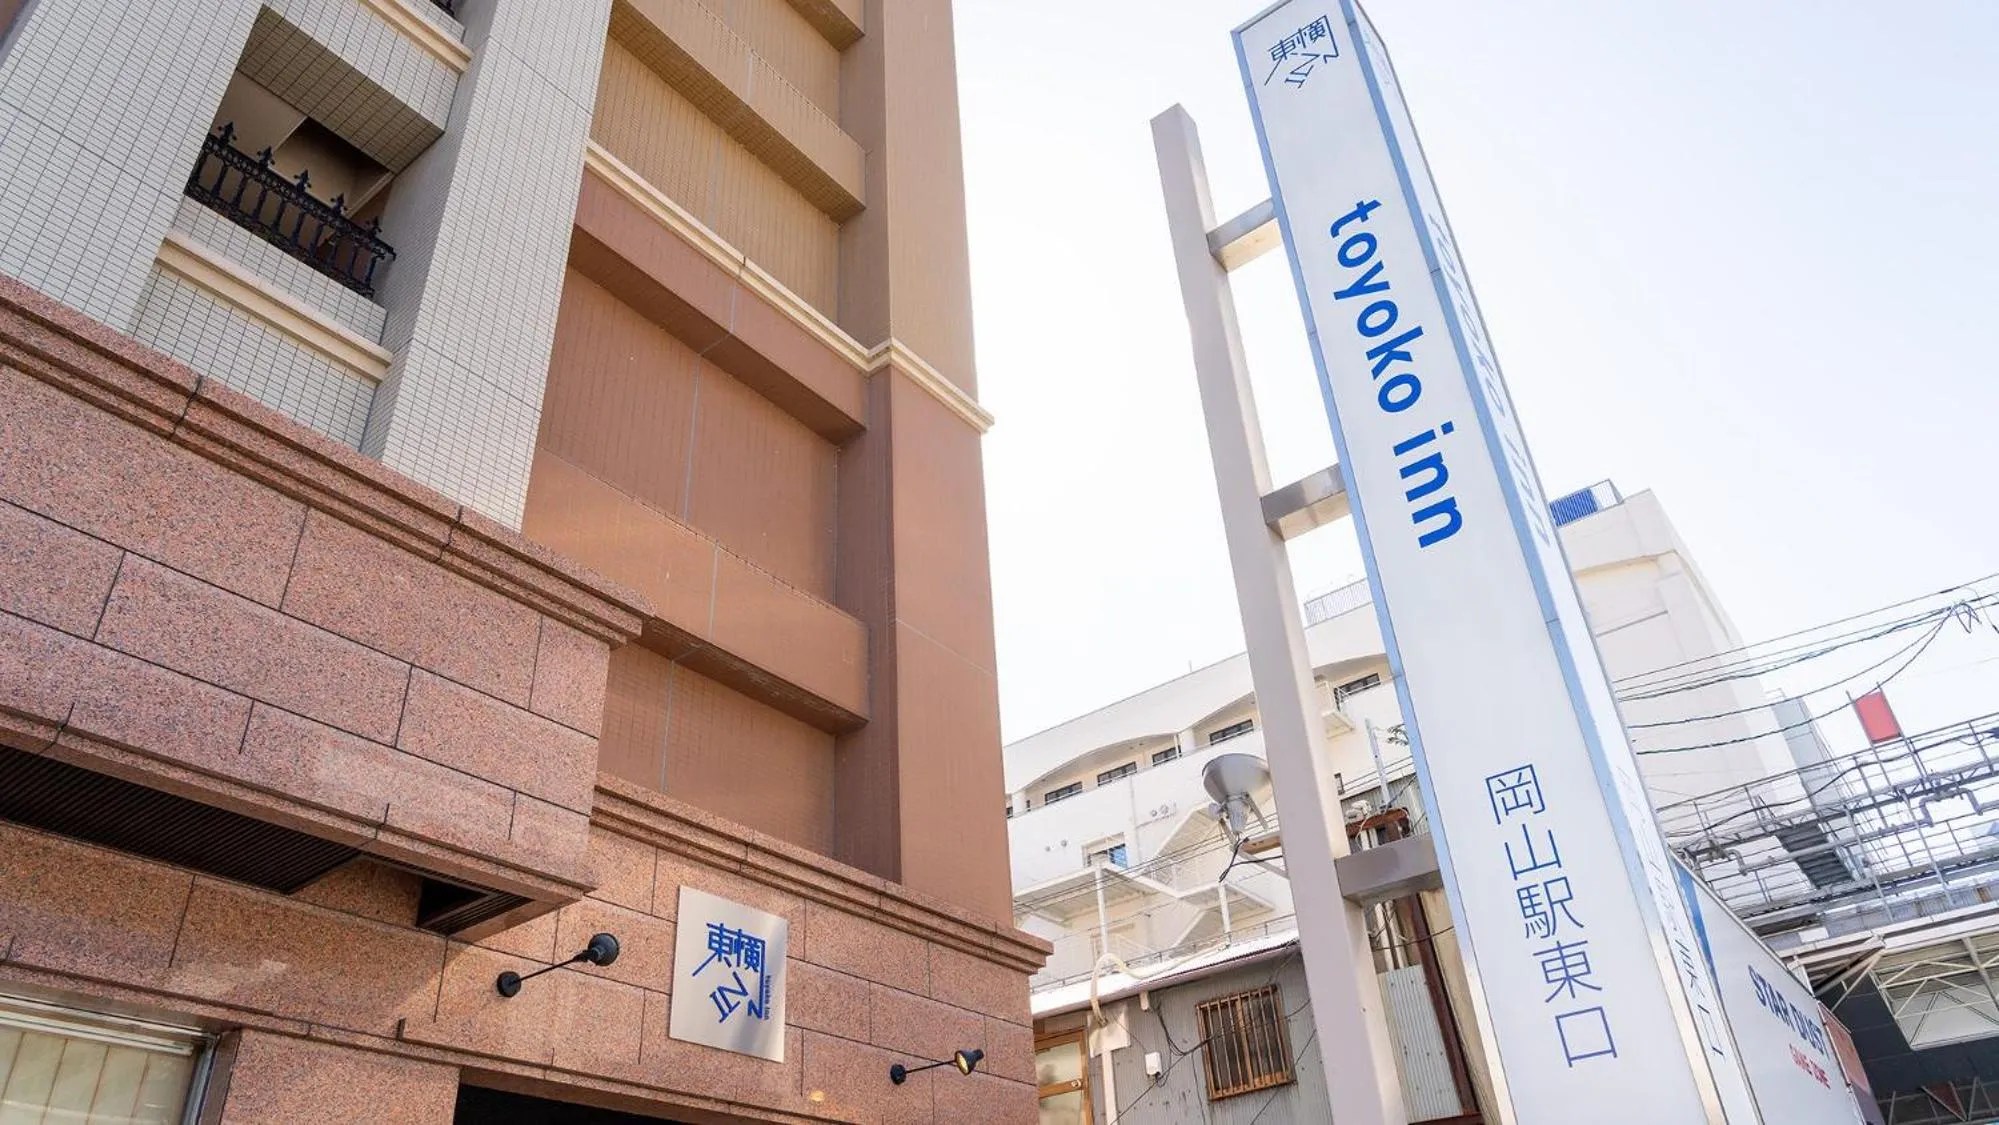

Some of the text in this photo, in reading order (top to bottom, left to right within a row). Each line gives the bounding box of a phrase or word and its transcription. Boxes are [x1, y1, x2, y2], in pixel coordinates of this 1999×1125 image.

[1330, 199, 1464, 549] toyoko inn
[1485, 763, 1618, 1068] 岡山駅東口
[1748, 964, 1830, 1061] STAR DUST
